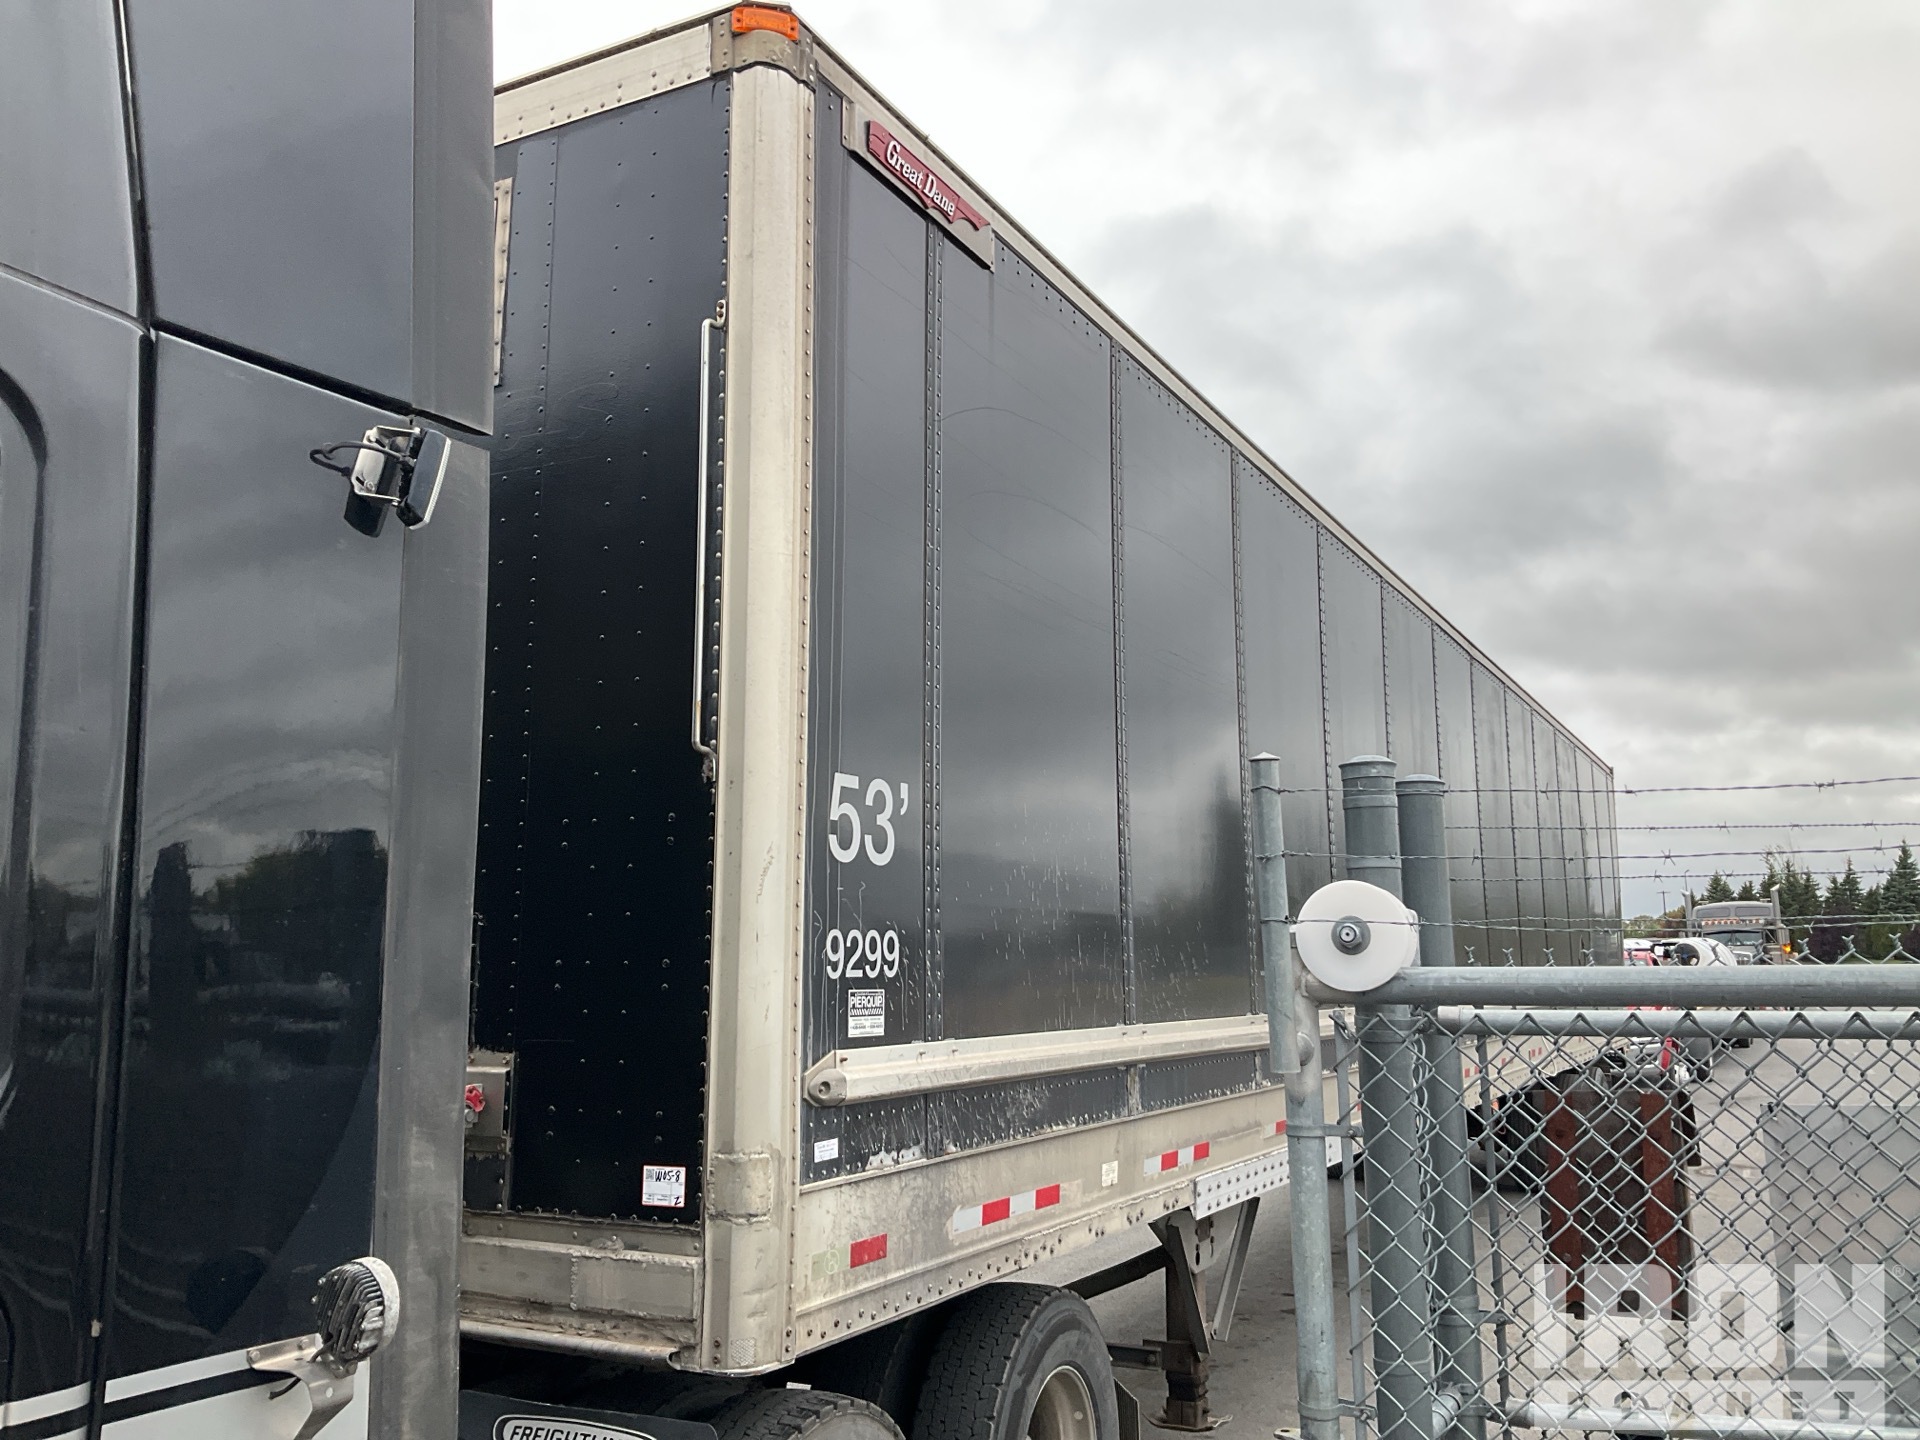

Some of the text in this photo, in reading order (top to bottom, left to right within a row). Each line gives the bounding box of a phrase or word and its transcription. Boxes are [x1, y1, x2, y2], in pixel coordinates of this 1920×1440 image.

[887, 140, 955, 215] Great Dane
[828, 772, 908, 866] 53'
[826, 929, 899, 979] 9299
[850, 995, 883, 1008] PIERQUIP
